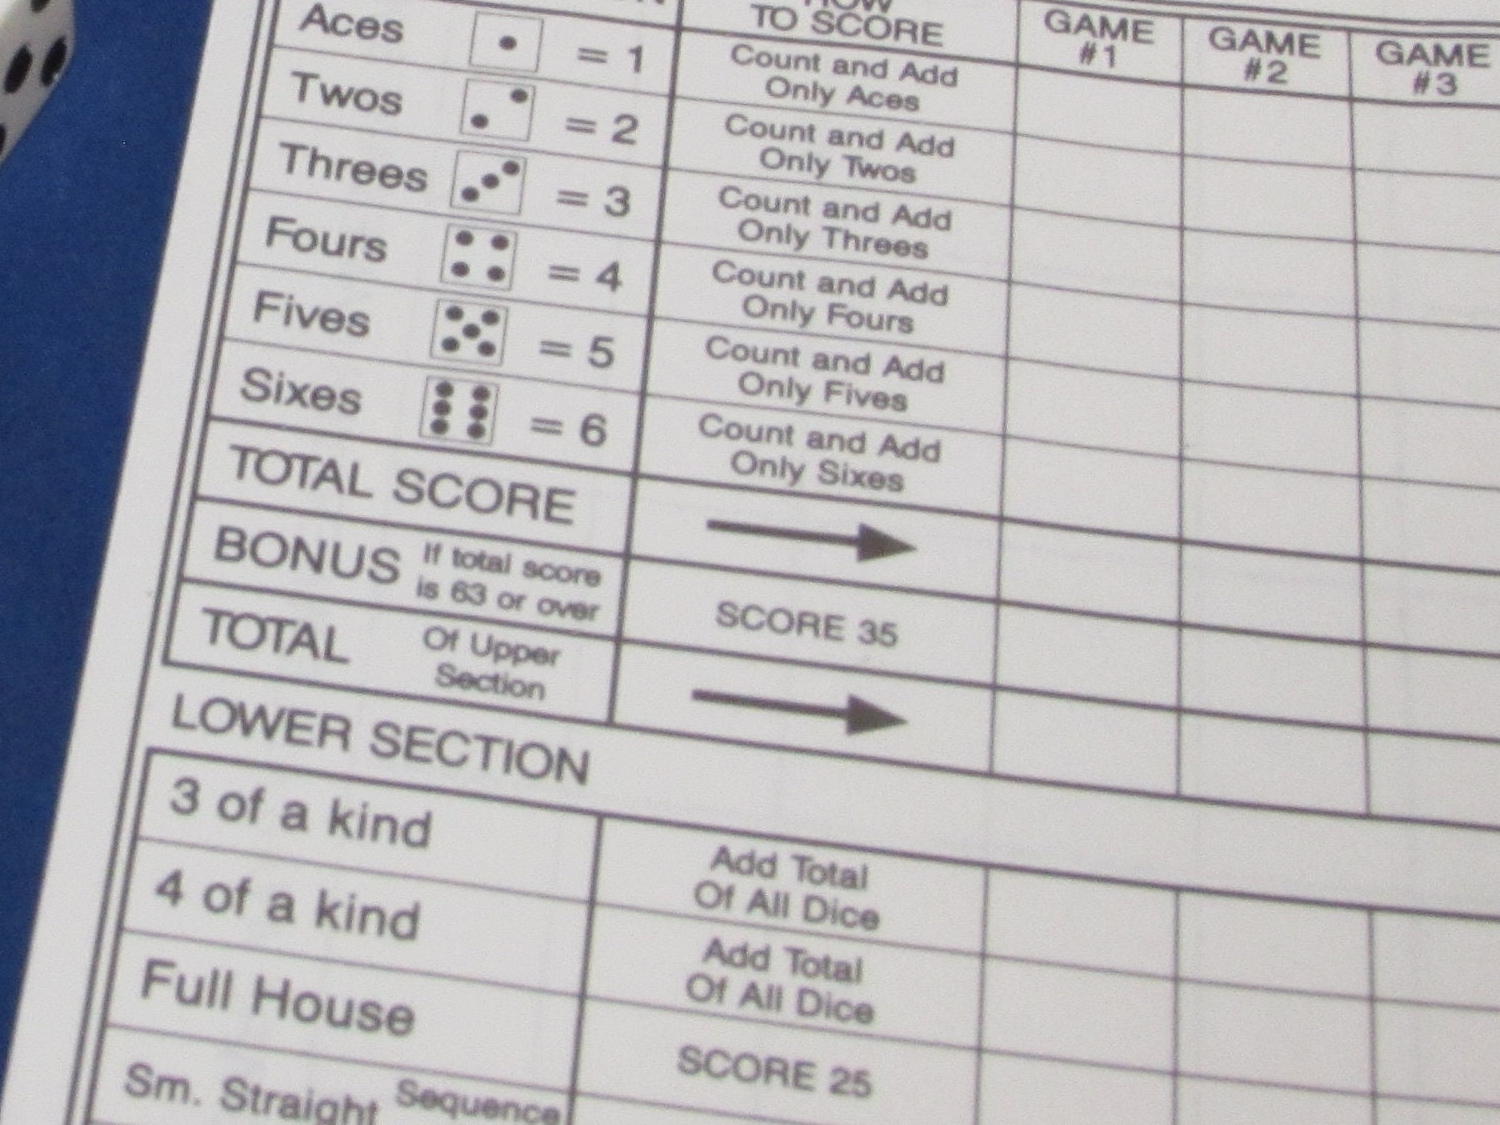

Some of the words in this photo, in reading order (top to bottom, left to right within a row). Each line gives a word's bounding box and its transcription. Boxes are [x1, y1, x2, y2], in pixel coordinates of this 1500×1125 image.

[299, 3, 403, 44] Aces
[751, 4, 798, 31] TO
[811, 10, 944, 47] SCORE
[1044, 8, 1154, 44] GAME
[1208, 26, 1320, 59] GAME
[731, 44, 820, 72] Count
[832, 59, 888, 79] and
[899, 62, 958, 87] Add
[1376, 40, 1490, 68] GAME
[291, 71, 402, 116] Twos
[765, 76, 835, 108] Only
[846, 85, 919, 112] Aces
[725, 113, 815, 143] Count
[827, 129, 884, 150] and
[896, 132, 955, 158] Add
[279, 142, 427, 192] Threes
[760, 147, 830, 180] Only
[843, 155, 916, 184] Twos
[719, 185, 810, 216] Count
[822, 201, 880, 223] and
[891, 204, 952, 231] Add
[266, 215, 387, 263] Fours
[738, 218, 810, 251] Only
[822, 226, 928, 259] Threes
[712, 260, 805, 291] Count
[817, 276, 875, 298] and
[887, 279, 948, 306] Add
[254, 290, 370, 338] Fives
[742, 294, 815, 329] Only
[828, 302, 914, 334] Fours
[705, 335, 800, 367] Count
[812, 352, 871, 375] and
[883, 355, 945, 384] Add
[240, 367, 361, 415] Sixes
[738, 371, 811, 406] Only
[824, 380, 907, 412] Fives
[699, 413, 794, 446] Count
[806, 431, 866, 454] and
[878, 434, 941, 463] Add
[230, 444, 373, 498] TOTAL
[393, 468, 576, 525] SCORE
[730, 450, 805, 487] Only
[818, 459, 904, 492] Sixes
[214, 525, 400, 585] BONUS
[424, 543, 444, 564] If
[452, 547, 511, 574] total
[523, 560, 601, 587] score
[416, 576, 439, 600] is
[451, 580, 487, 606] 63
[497, 592, 526, 610] or
[537, 598, 600, 621] over
[202, 607, 350, 664] TOTAL
[423, 626, 459, 651] Of
[471, 633, 560, 666] Upper
[716, 601, 845, 641] SCORE
[858, 619, 898, 647] 35
[435, 663, 545, 700] Section
[172, 693, 352, 752] LOWER
[370, 721, 590, 785] SECTION
[170, 777, 200, 815] 3
[217, 786, 265, 824] of
[280, 800, 308, 832] a
[328, 798, 432, 849] kind
[710, 845, 777, 879] Add
[791, 854, 868, 890] Total
[155, 869, 183, 906] 4
[203, 877, 251, 915] of
[267, 892, 295, 924] a
[315, 889, 420, 941] kind
[694, 880, 735, 909] Of
[746, 888, 789, 918] All
[803, 895, 880, 931] Dice
[702, 937, 770, 972] Add
[785, 947, 862, 983] Total
[141, 958, 233, 1010] Full
[252, 975, 415, 1037] House
[686, 973, 727, 1003] Of
[739, 981, 783, 1012] All
[796, 987, 875, 1025] Dice
[124, 1062, 199, 1105] Sm.
[220, 1076, 378, 1125] Straight
[396, 1078, 561, 1125] Sequence
[678, 1045, 815, 1091] SCORE
[829, 1066, 872, 1098] 25
